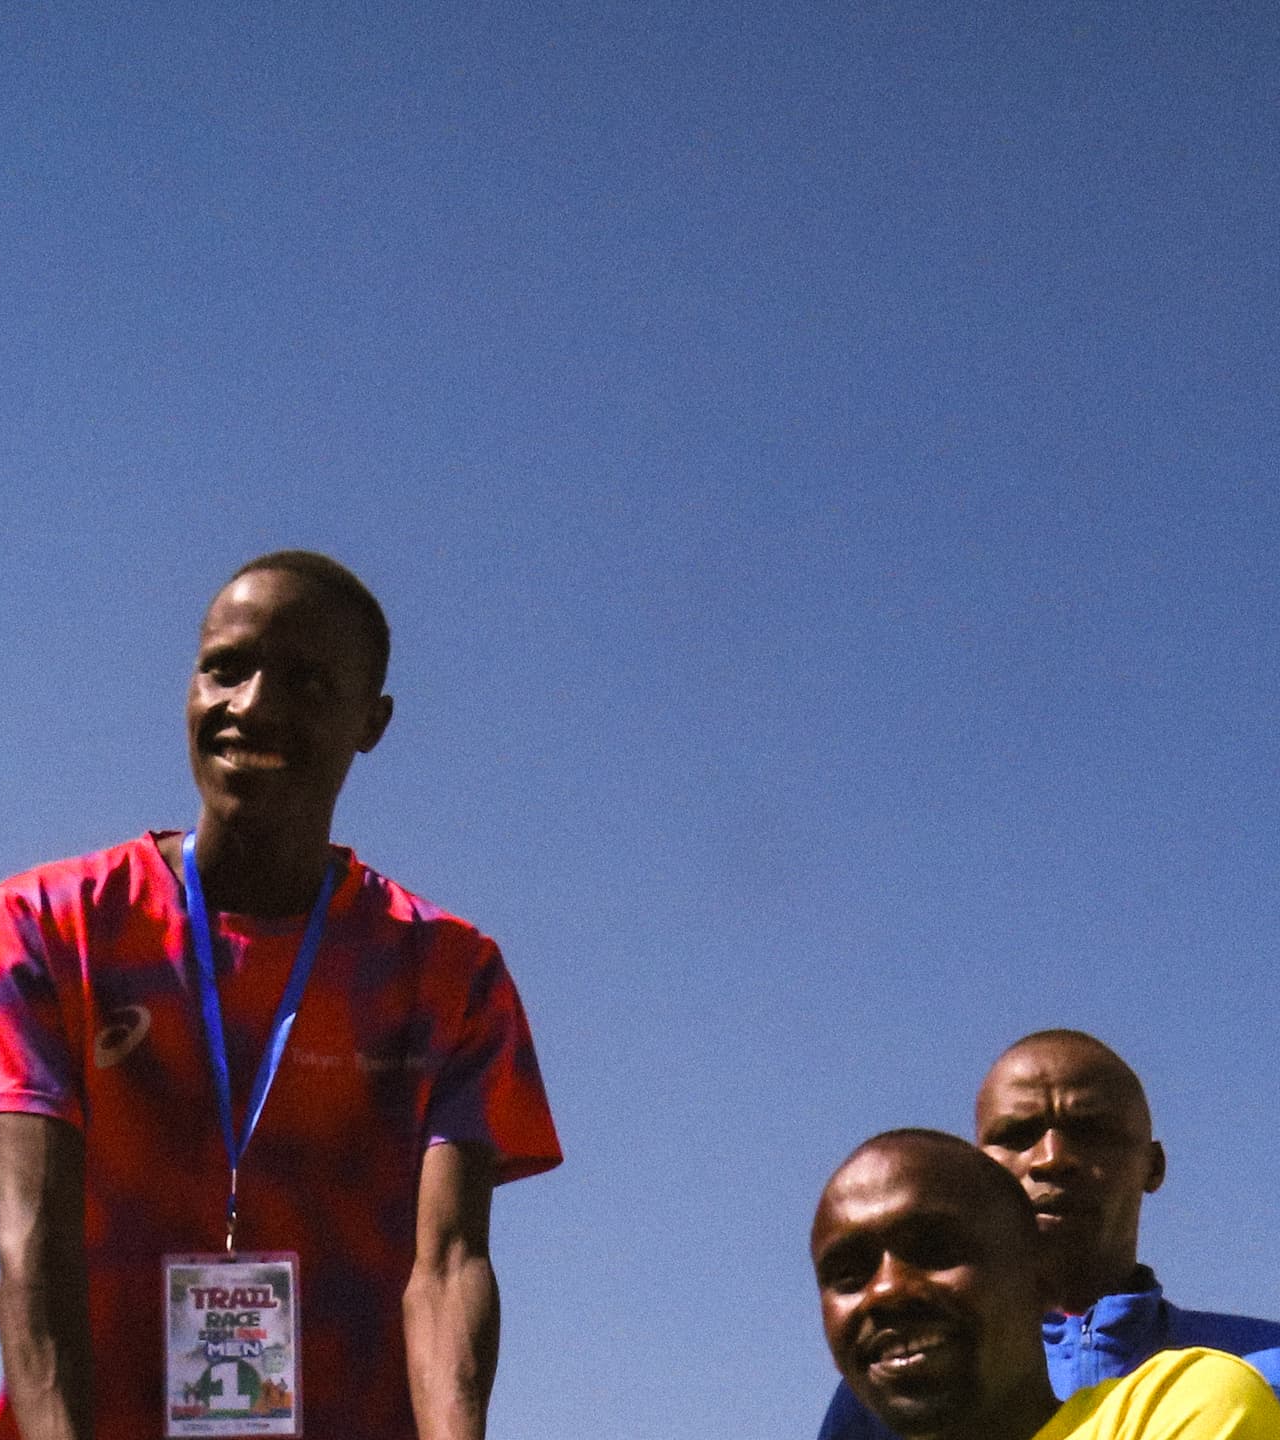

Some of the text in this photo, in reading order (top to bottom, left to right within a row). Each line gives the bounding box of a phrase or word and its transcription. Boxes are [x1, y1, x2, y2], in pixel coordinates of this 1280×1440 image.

[189, 1286, 278, 1311] TRAIL
[206, 1311, 261, 1328] RACE
[207, 1341, 261, 1357] MEN
[209, 1361, 251, 1410] 1
